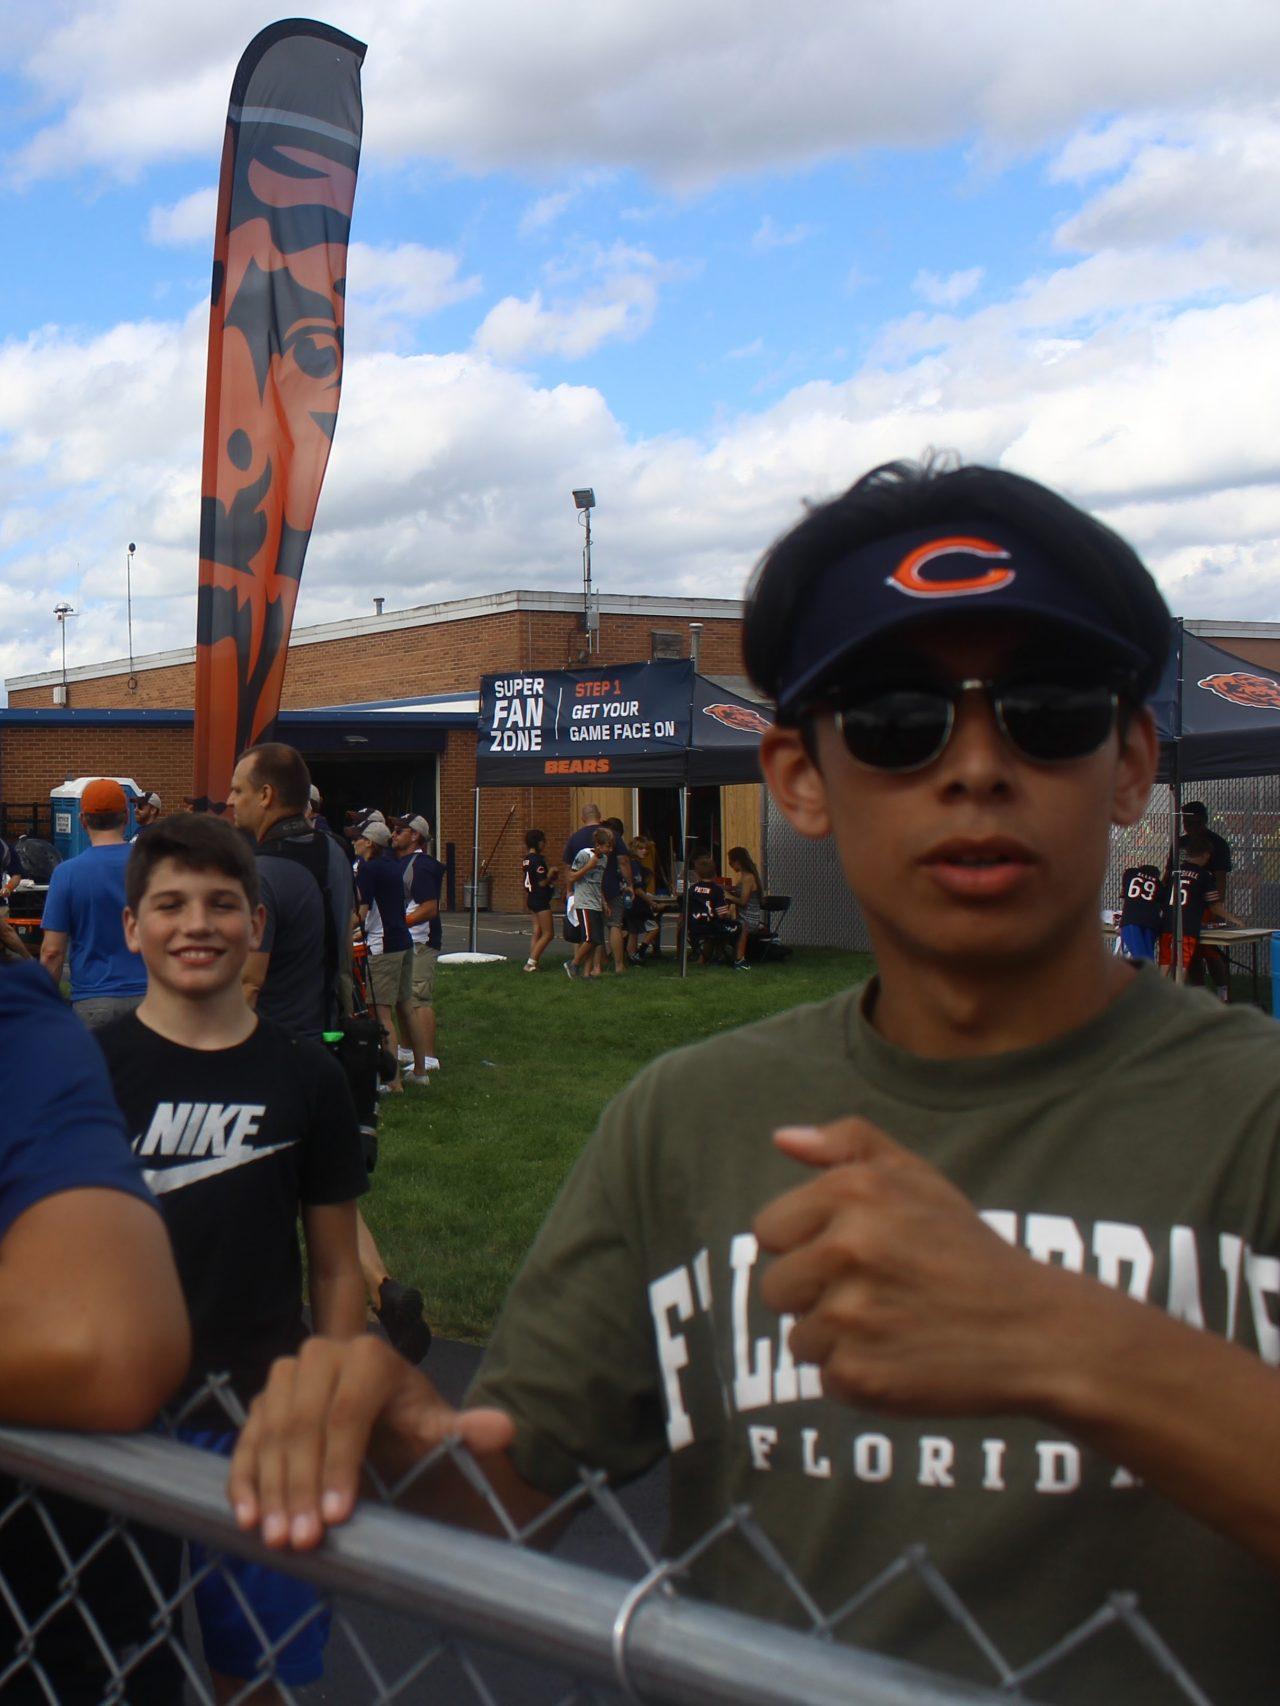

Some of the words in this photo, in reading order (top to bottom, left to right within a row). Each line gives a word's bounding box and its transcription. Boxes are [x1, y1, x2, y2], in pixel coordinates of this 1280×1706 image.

[494, 678, 544, 698] SUPER
[575, 681, 610, 697] STEP
[613, 680, 621, 695] 1
[492, 697, 543, 729] FAN
[572, 703, 600, 719] GET
[602, 701, 639, 718] YOUR
[489, 730, 542, 752] ZONE
[569, 725, 611, 741] GAME
[614, 723, 651, 739] FACE
[654, 721, 675, 737] ON
[544, 759, 610, 775] BEARS
[1127, 877, 1156, 901] 69
[139, 1102, 266, 1157] NIKE
[748, 1424, 1144, 1494] FLORID
